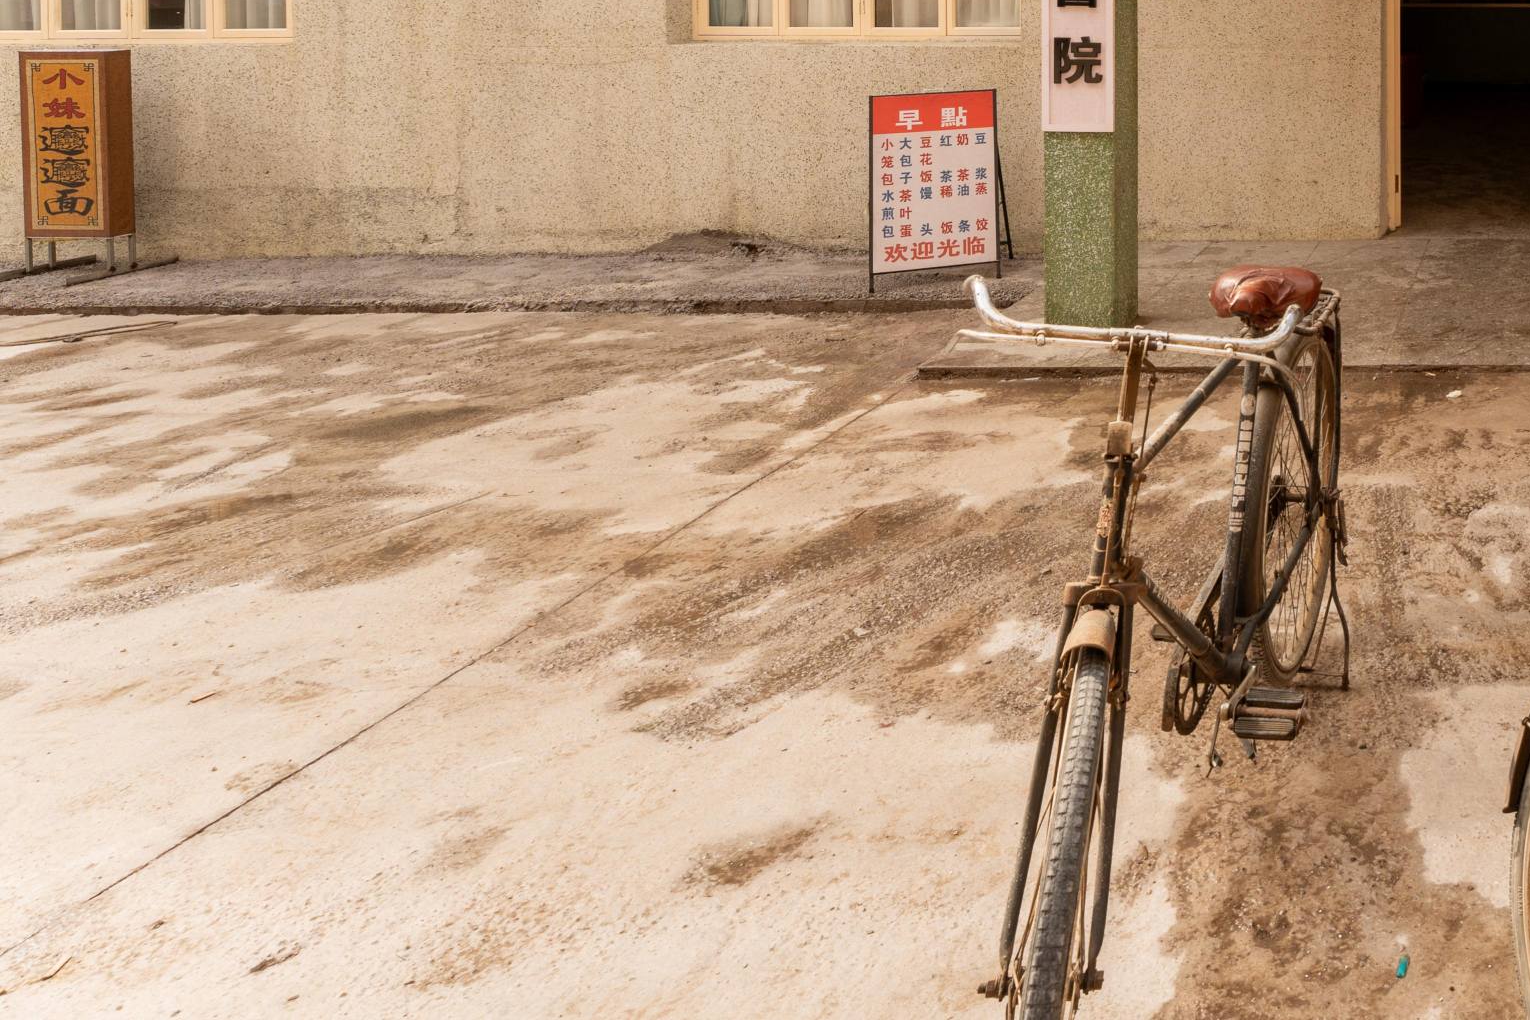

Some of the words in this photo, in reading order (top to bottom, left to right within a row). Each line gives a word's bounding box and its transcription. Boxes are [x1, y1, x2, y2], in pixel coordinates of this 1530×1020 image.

[896, 106, 968, 130] 早點
[884, 236, 986, 264] 欢迎光临
